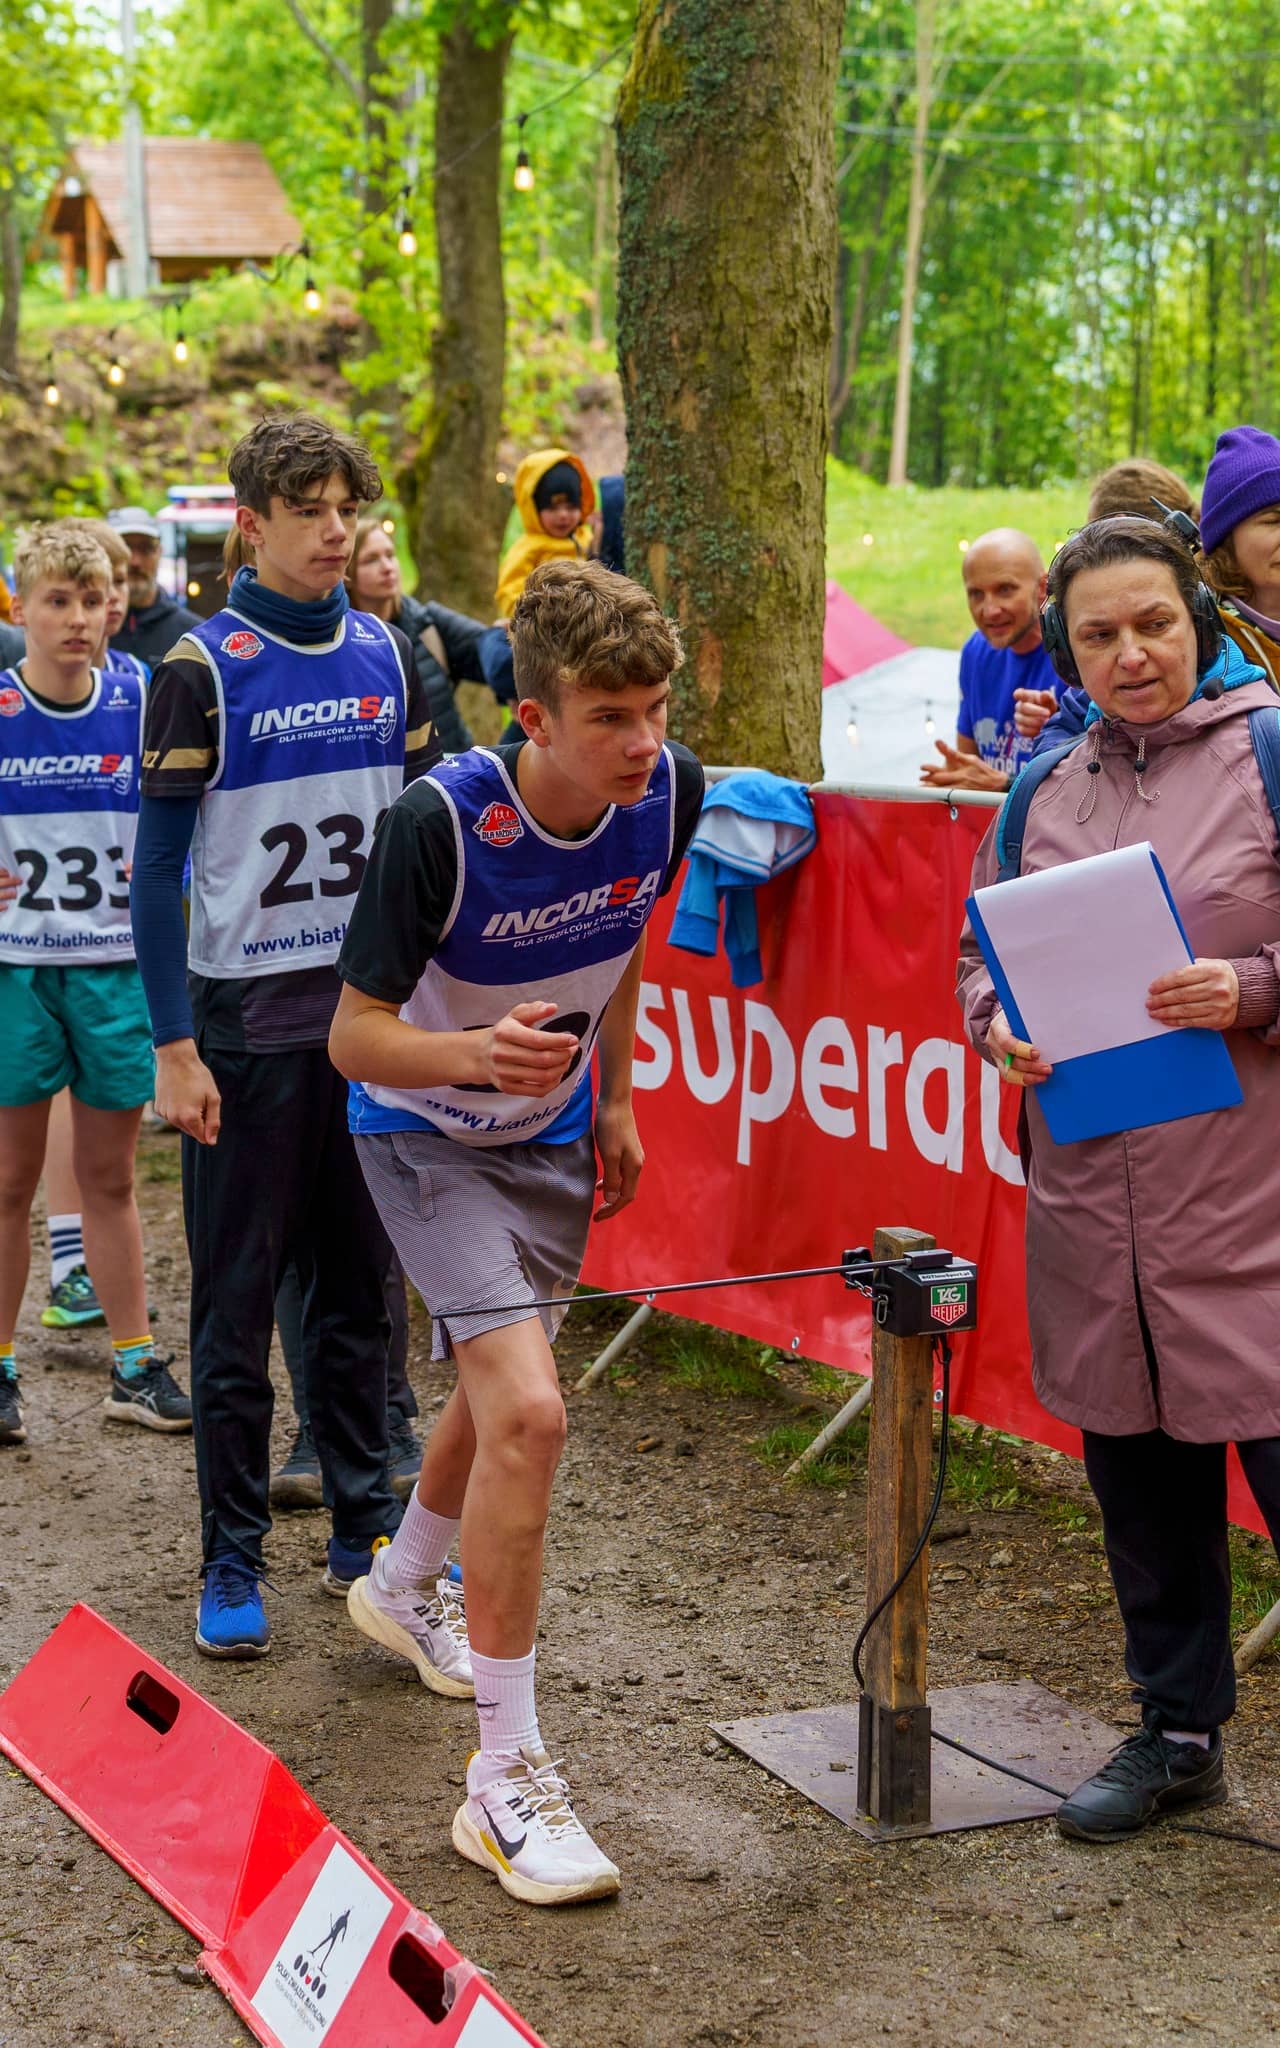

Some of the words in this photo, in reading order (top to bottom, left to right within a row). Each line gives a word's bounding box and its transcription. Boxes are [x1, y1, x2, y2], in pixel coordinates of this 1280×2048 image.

[249, 695, 396, 737] INCORSA
[0, 754, 133, 777] INCORSA
[260, 808, 391, 908] 23
[480, 868, 661, 937] INCORSA
[512, 938, 534, 949] DLA
[937, 1286, 962, 1304] TAG
[934, 1304, 965, 1322] HEUER
